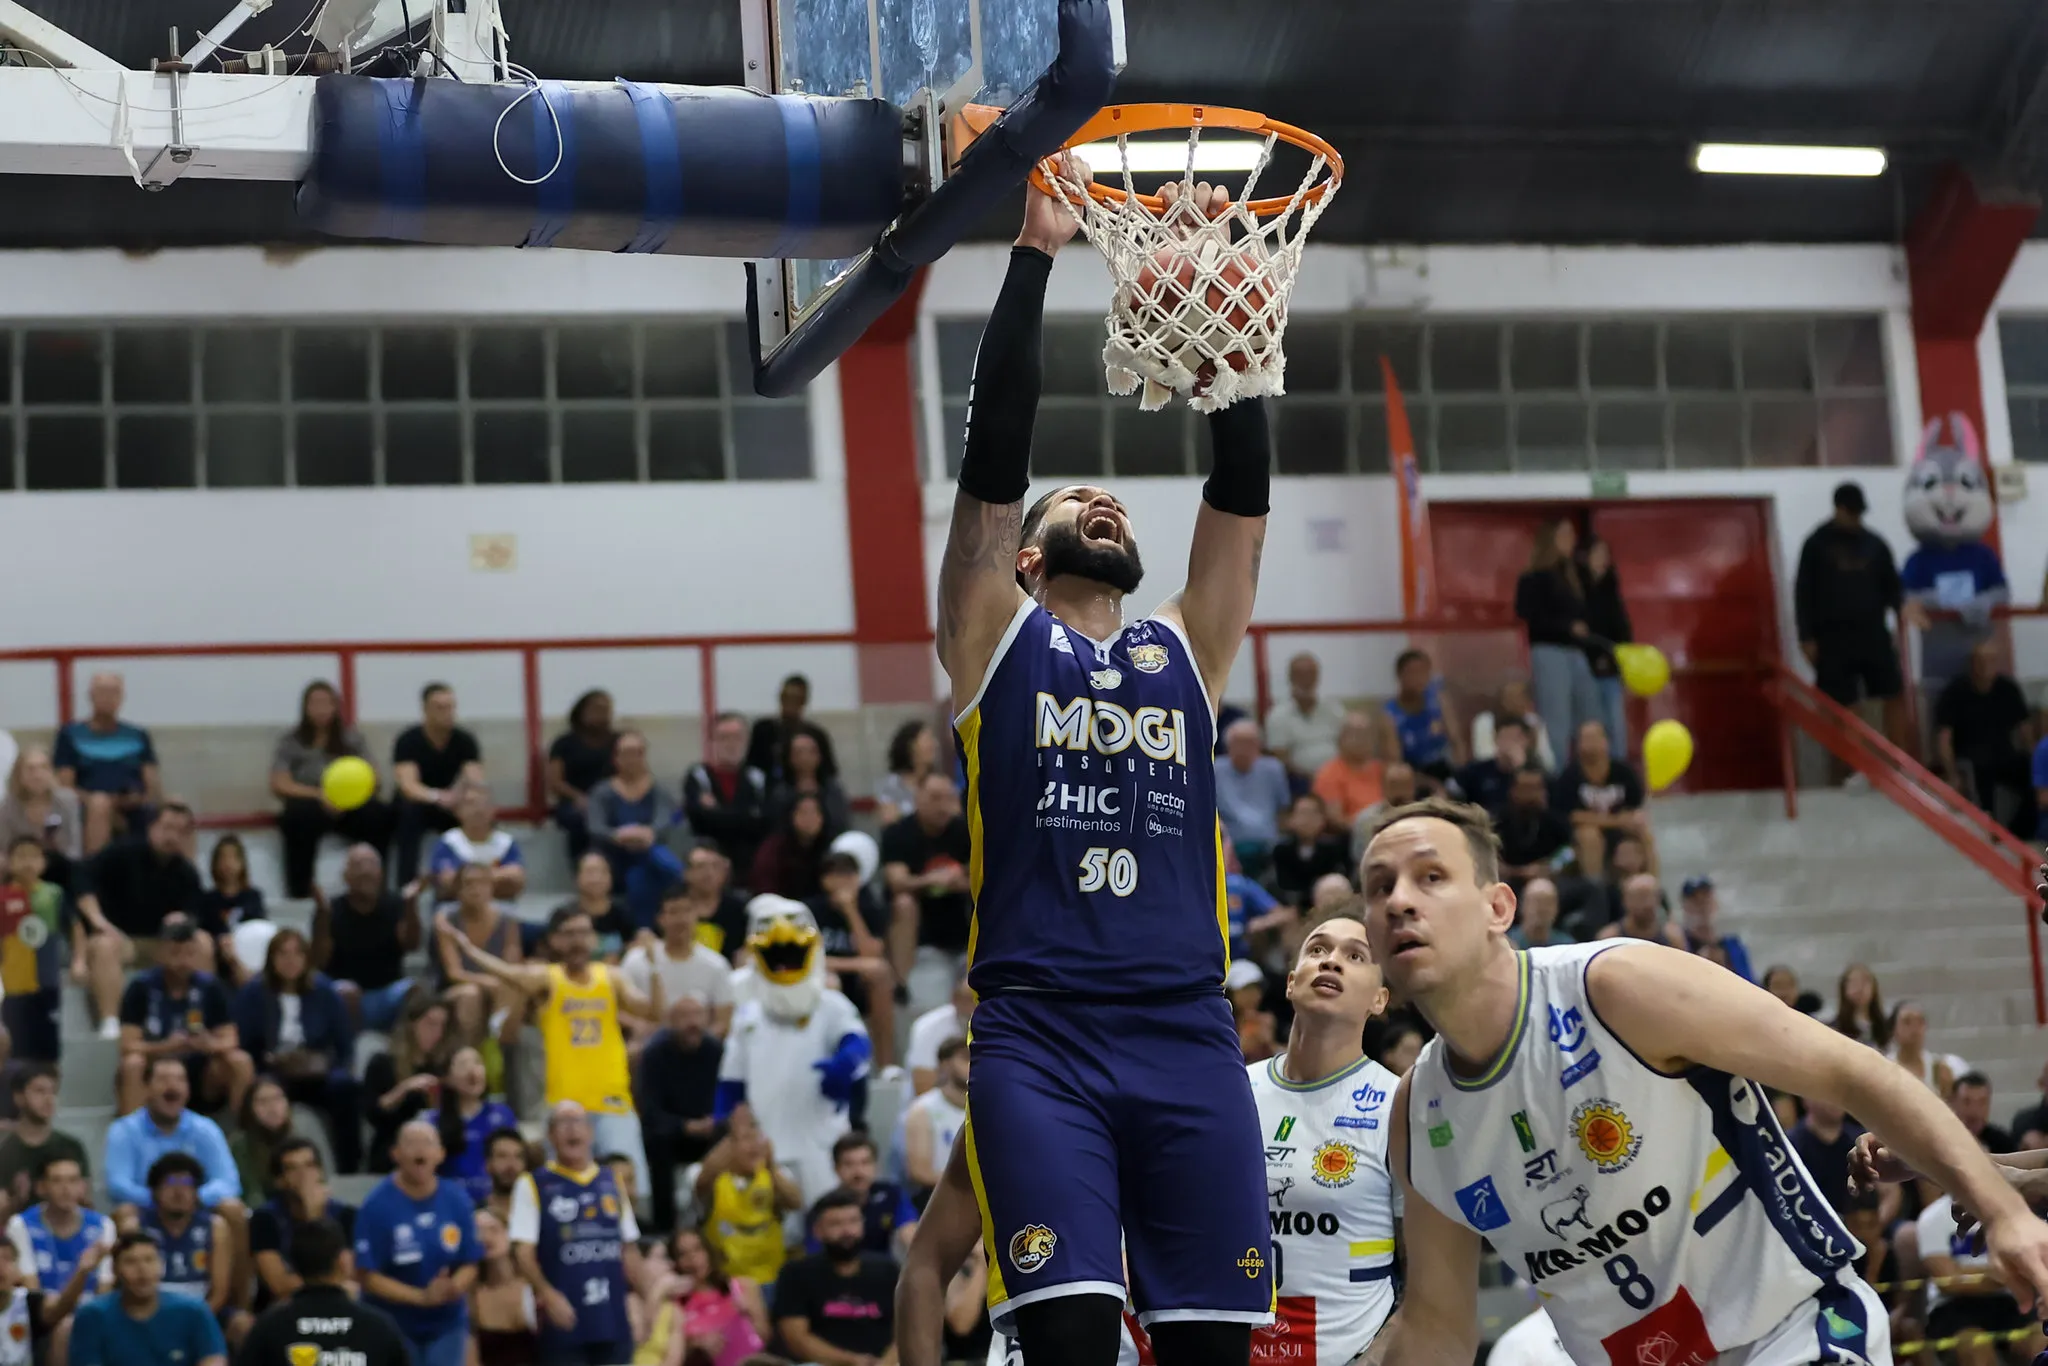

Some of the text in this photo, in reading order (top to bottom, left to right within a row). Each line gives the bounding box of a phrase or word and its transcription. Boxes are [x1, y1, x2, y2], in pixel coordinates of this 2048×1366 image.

[1035, 691, 1187, 767] MOGI
[1147, 790, 1185, 812] necton
[1035, 815, 1121, 832] Inestimentos
[1149, 819, 1162, 835] btg
[1078, 847, 1139, 897] 50
[1603, 1253, 1656, 1310] 8
